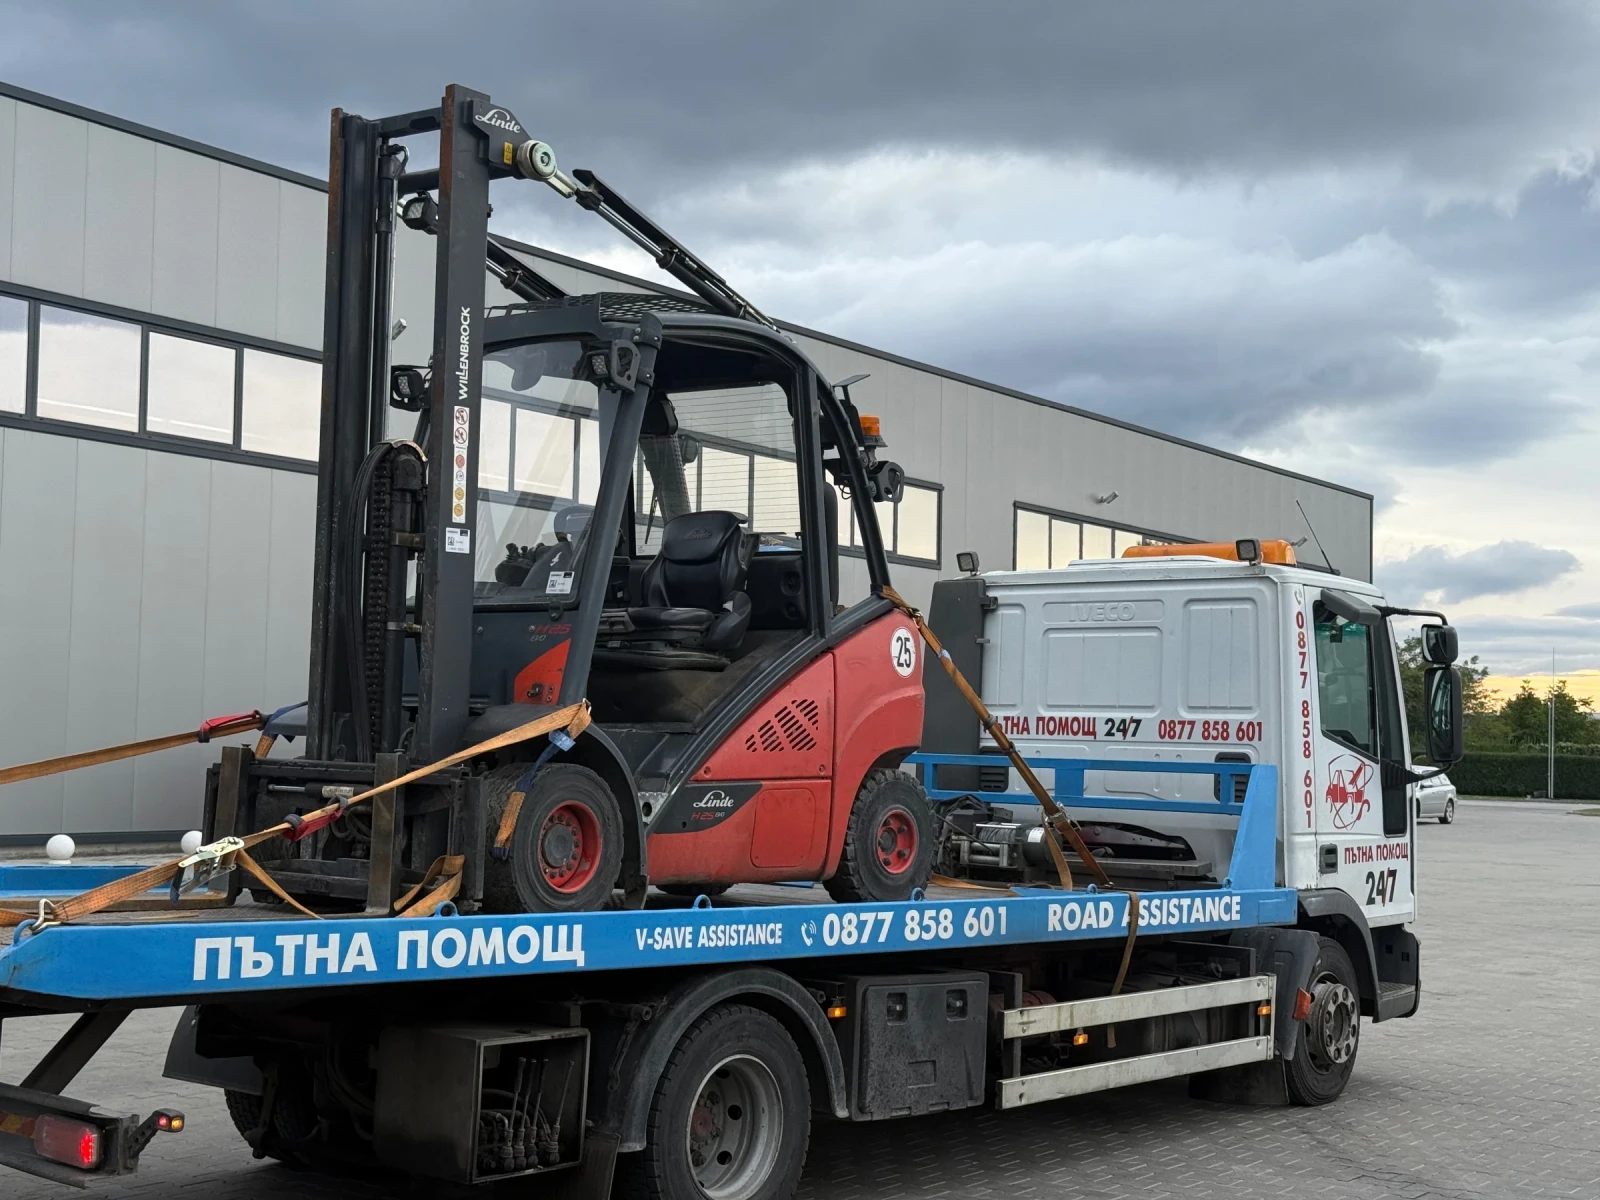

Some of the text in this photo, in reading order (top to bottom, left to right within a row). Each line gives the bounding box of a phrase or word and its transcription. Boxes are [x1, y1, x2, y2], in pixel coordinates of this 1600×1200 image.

[475, 108, 521, 133] Linde
[455, 306, 471, 400] WILLENBROCK
[1069, 602, 1136, 622] IVECO
[896, 636, 912, 668] 25
[983, 715, 1031, 735] ЪТНА
[1035, 716, 1097, 740] ПОМОЩ
[1158, 719, 1263, 742] 0877 858 601
[1295, 611, 1313, 829] 0877 858 601
[693, 790, 734, 808] Linde
[1344, 842, 1409, 865] ПЪТНА ПОМОЩ
[822, 906, 1007, 946] 0877 858 601
[1048, 901, 1114, 932] ROAD
[636, 923, 783, 950] V-SAVE ASSISTANCE
[193, 924, 585, 981] ПЪТНА ПОМОЩ
